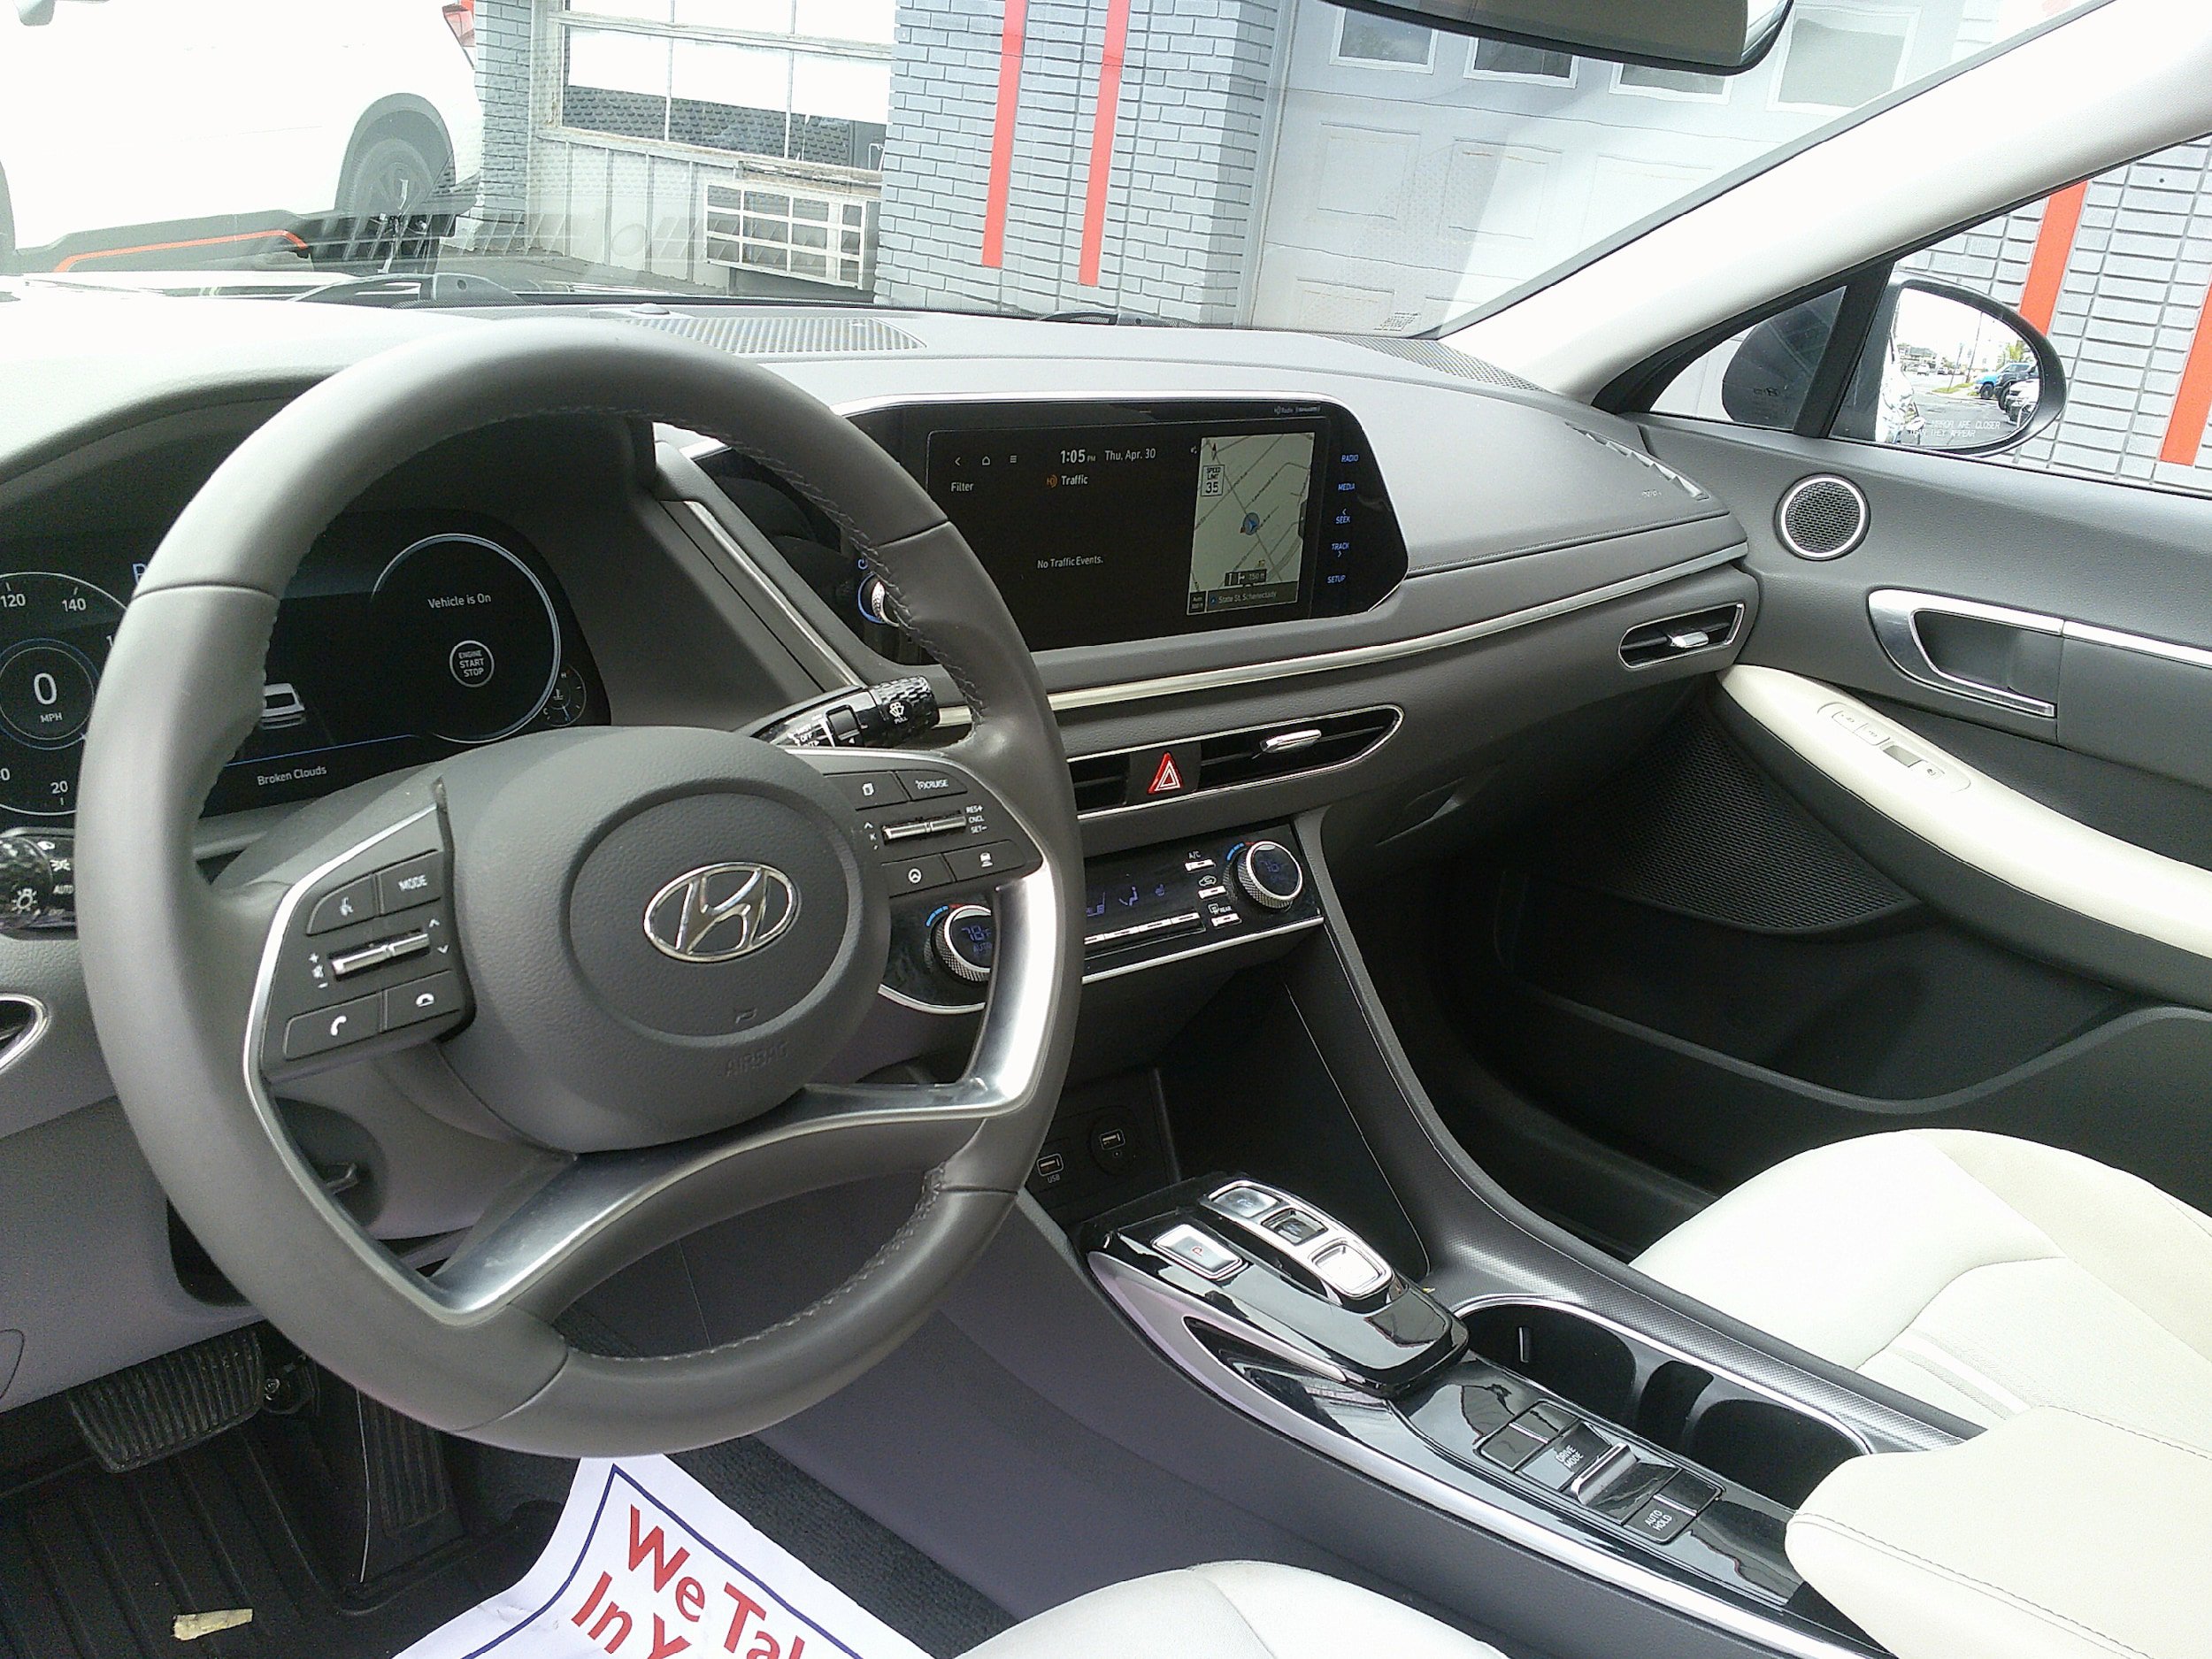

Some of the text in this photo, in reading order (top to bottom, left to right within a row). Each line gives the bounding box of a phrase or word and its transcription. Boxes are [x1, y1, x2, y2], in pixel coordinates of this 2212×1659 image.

[1975, 420, 2001, 430] CLOSER
[1060, 449, 1087, 465] 1:05
[1105, 449, 1124, 461] Thu.
[1125, 449, 1143, 461] Apr.
[1145, 448, 1156, 459] 30
[1340, 454, 1359, 463] RADIO
[950, 481, 973, 492] Filter
[1061, 474, 1088, 486] Traffic
[1205, 481, 1219, 494] 35
[1037, 556, 1104, 569] No Traffic Events.
[1327, 574, 1346, 584] SETUP
[0, 593, 27, 608] 120
[62, 598, 87, 612] 140
[427, 593, 492, 609] Vehicle is On
[457, 649, 483, 660] ENGINE
[458, 658, 485, 669] START
[463, 667, 485, 678] STOP
[33, 672, 58, 705] 0
[40, 712, 64, 723] MPH
[893, 716, 909, 725] PULL
[0, 768, 11, 781] 0
[257, 765, 327, 786] Broken Clouds
[50, 780, 69, 795] 20
[926, 779, 949, 789] CRUISE
[1188, 850, 1202, 860] A/C
[398, 874, 428, 892] MODE
[1047, 1174, 1061, 1184] USB
[1555, 1445, 1576, 1463] DRIVE
[1563, 1451, 1584, 1469] MODE
[1645, 1509, 1663, 1527] AUTO
[1652, 1514, 1672, 1532] HOLD
[627, 1502, 705, 1623] We
[571, 1571, 633, 1655] In
